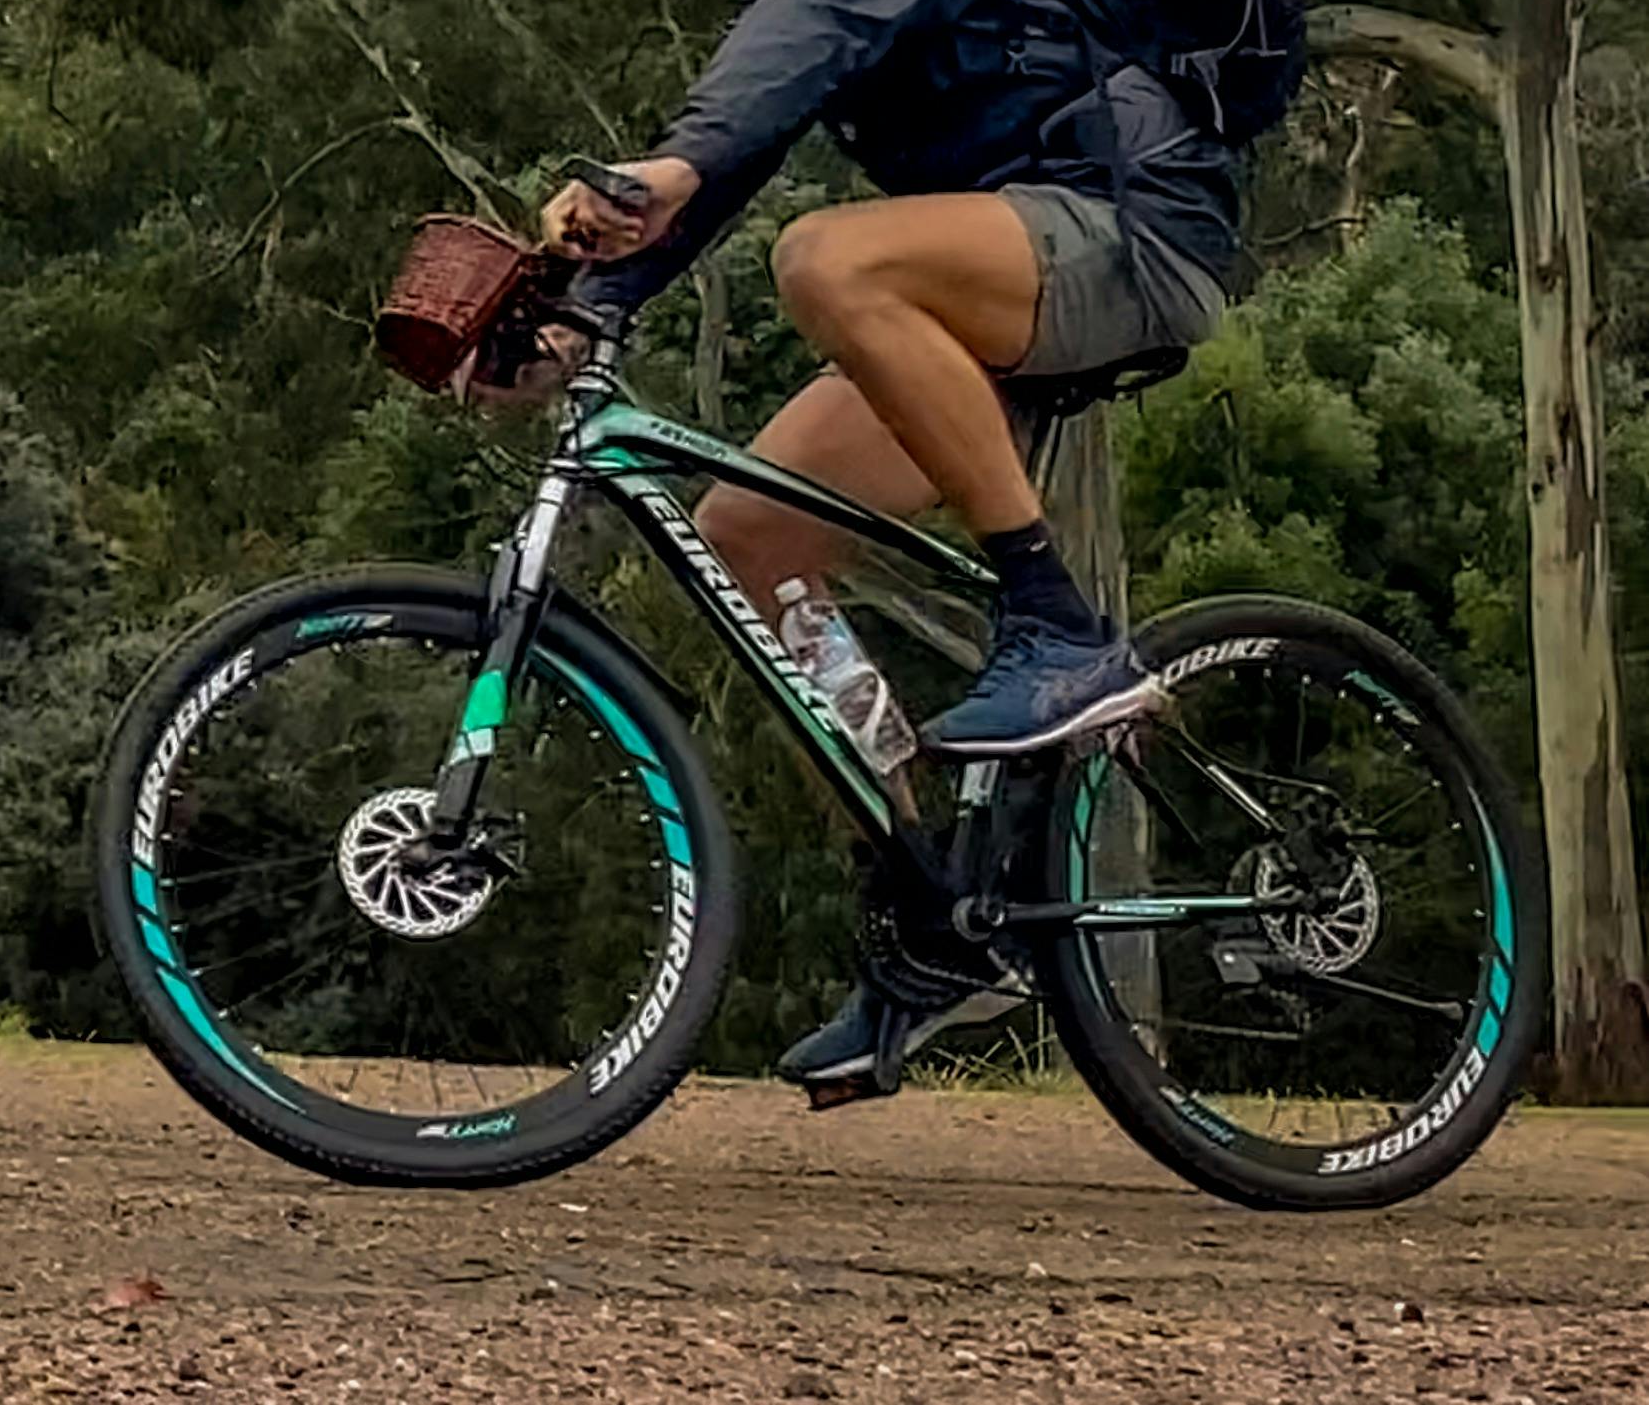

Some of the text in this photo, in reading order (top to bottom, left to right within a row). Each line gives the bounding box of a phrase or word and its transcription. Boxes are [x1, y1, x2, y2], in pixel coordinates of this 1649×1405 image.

[1163, 637, 1282, 688] OBIKE
[132, 647, 254, 864] EUROBIKE
[589, 862, 695, 1097] EUROBIKE
[1317, 1047, 1487, 1175] EUROBIKE
